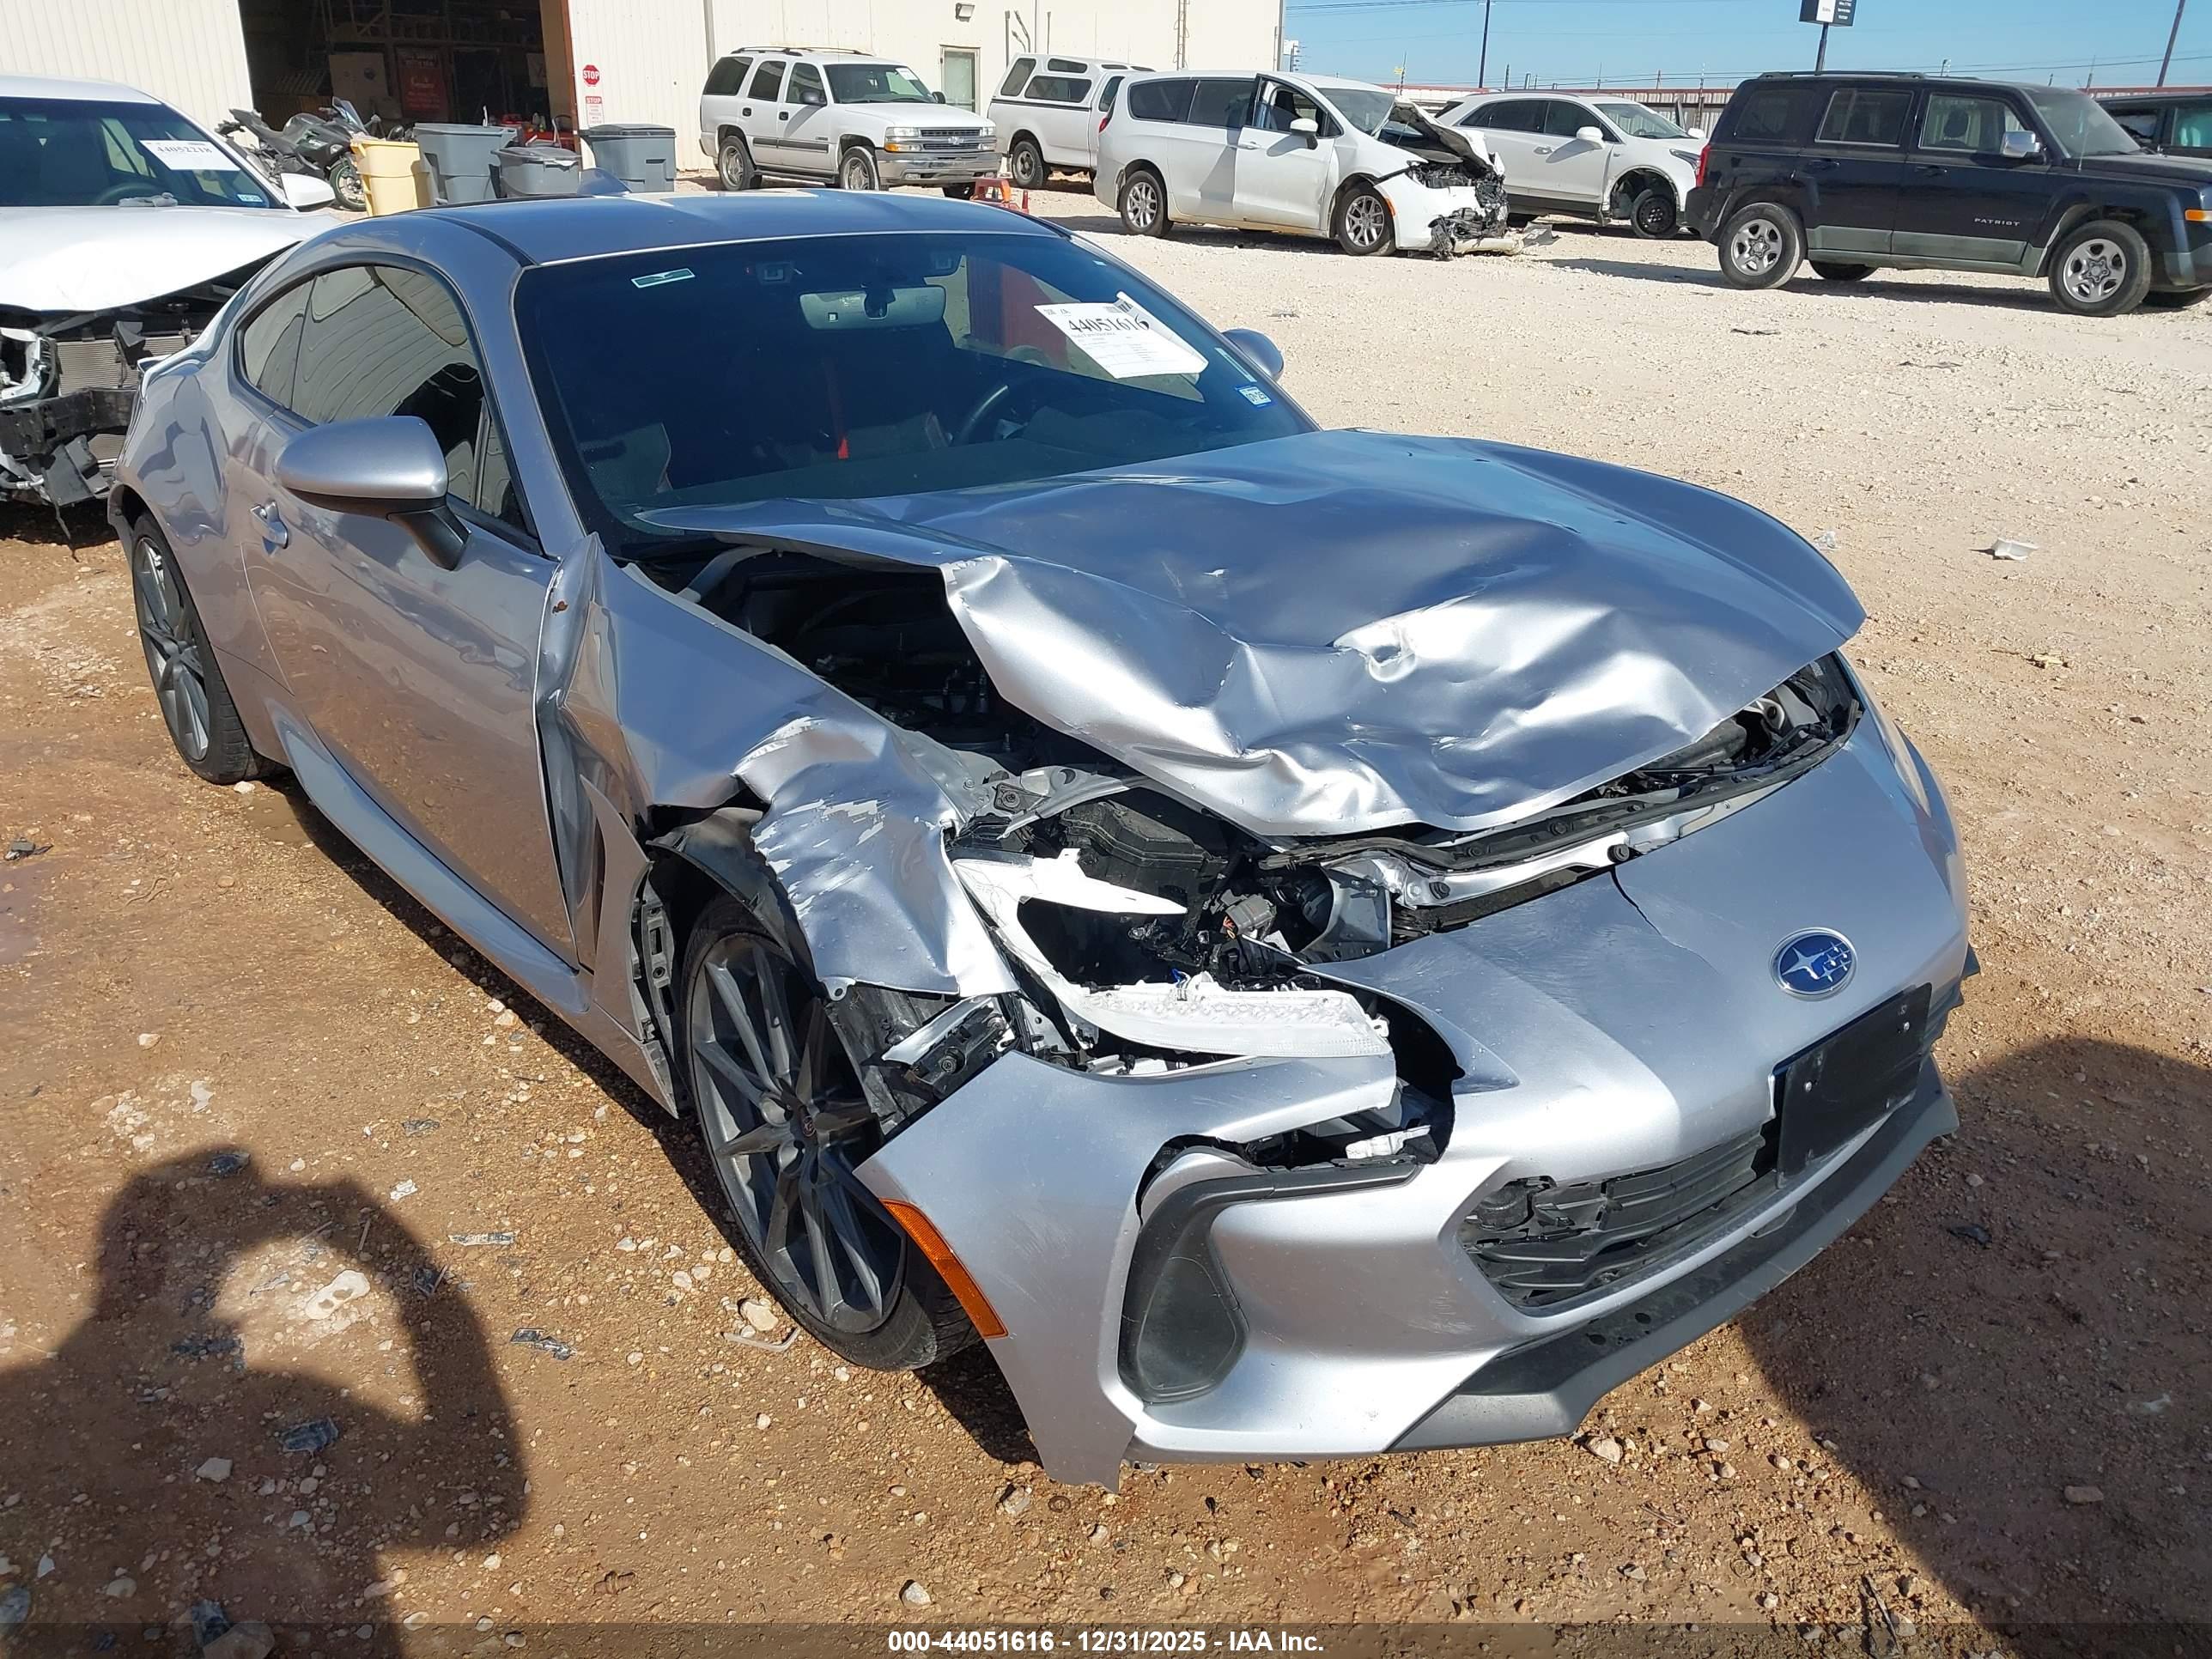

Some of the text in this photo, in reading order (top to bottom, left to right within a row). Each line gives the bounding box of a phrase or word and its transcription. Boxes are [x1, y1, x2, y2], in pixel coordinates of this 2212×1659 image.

[584, 70, 599, 79] STOP
[1974, 217, 2021, 227] PATRIOT
[1068, 314, 1150, 333] 44051616
